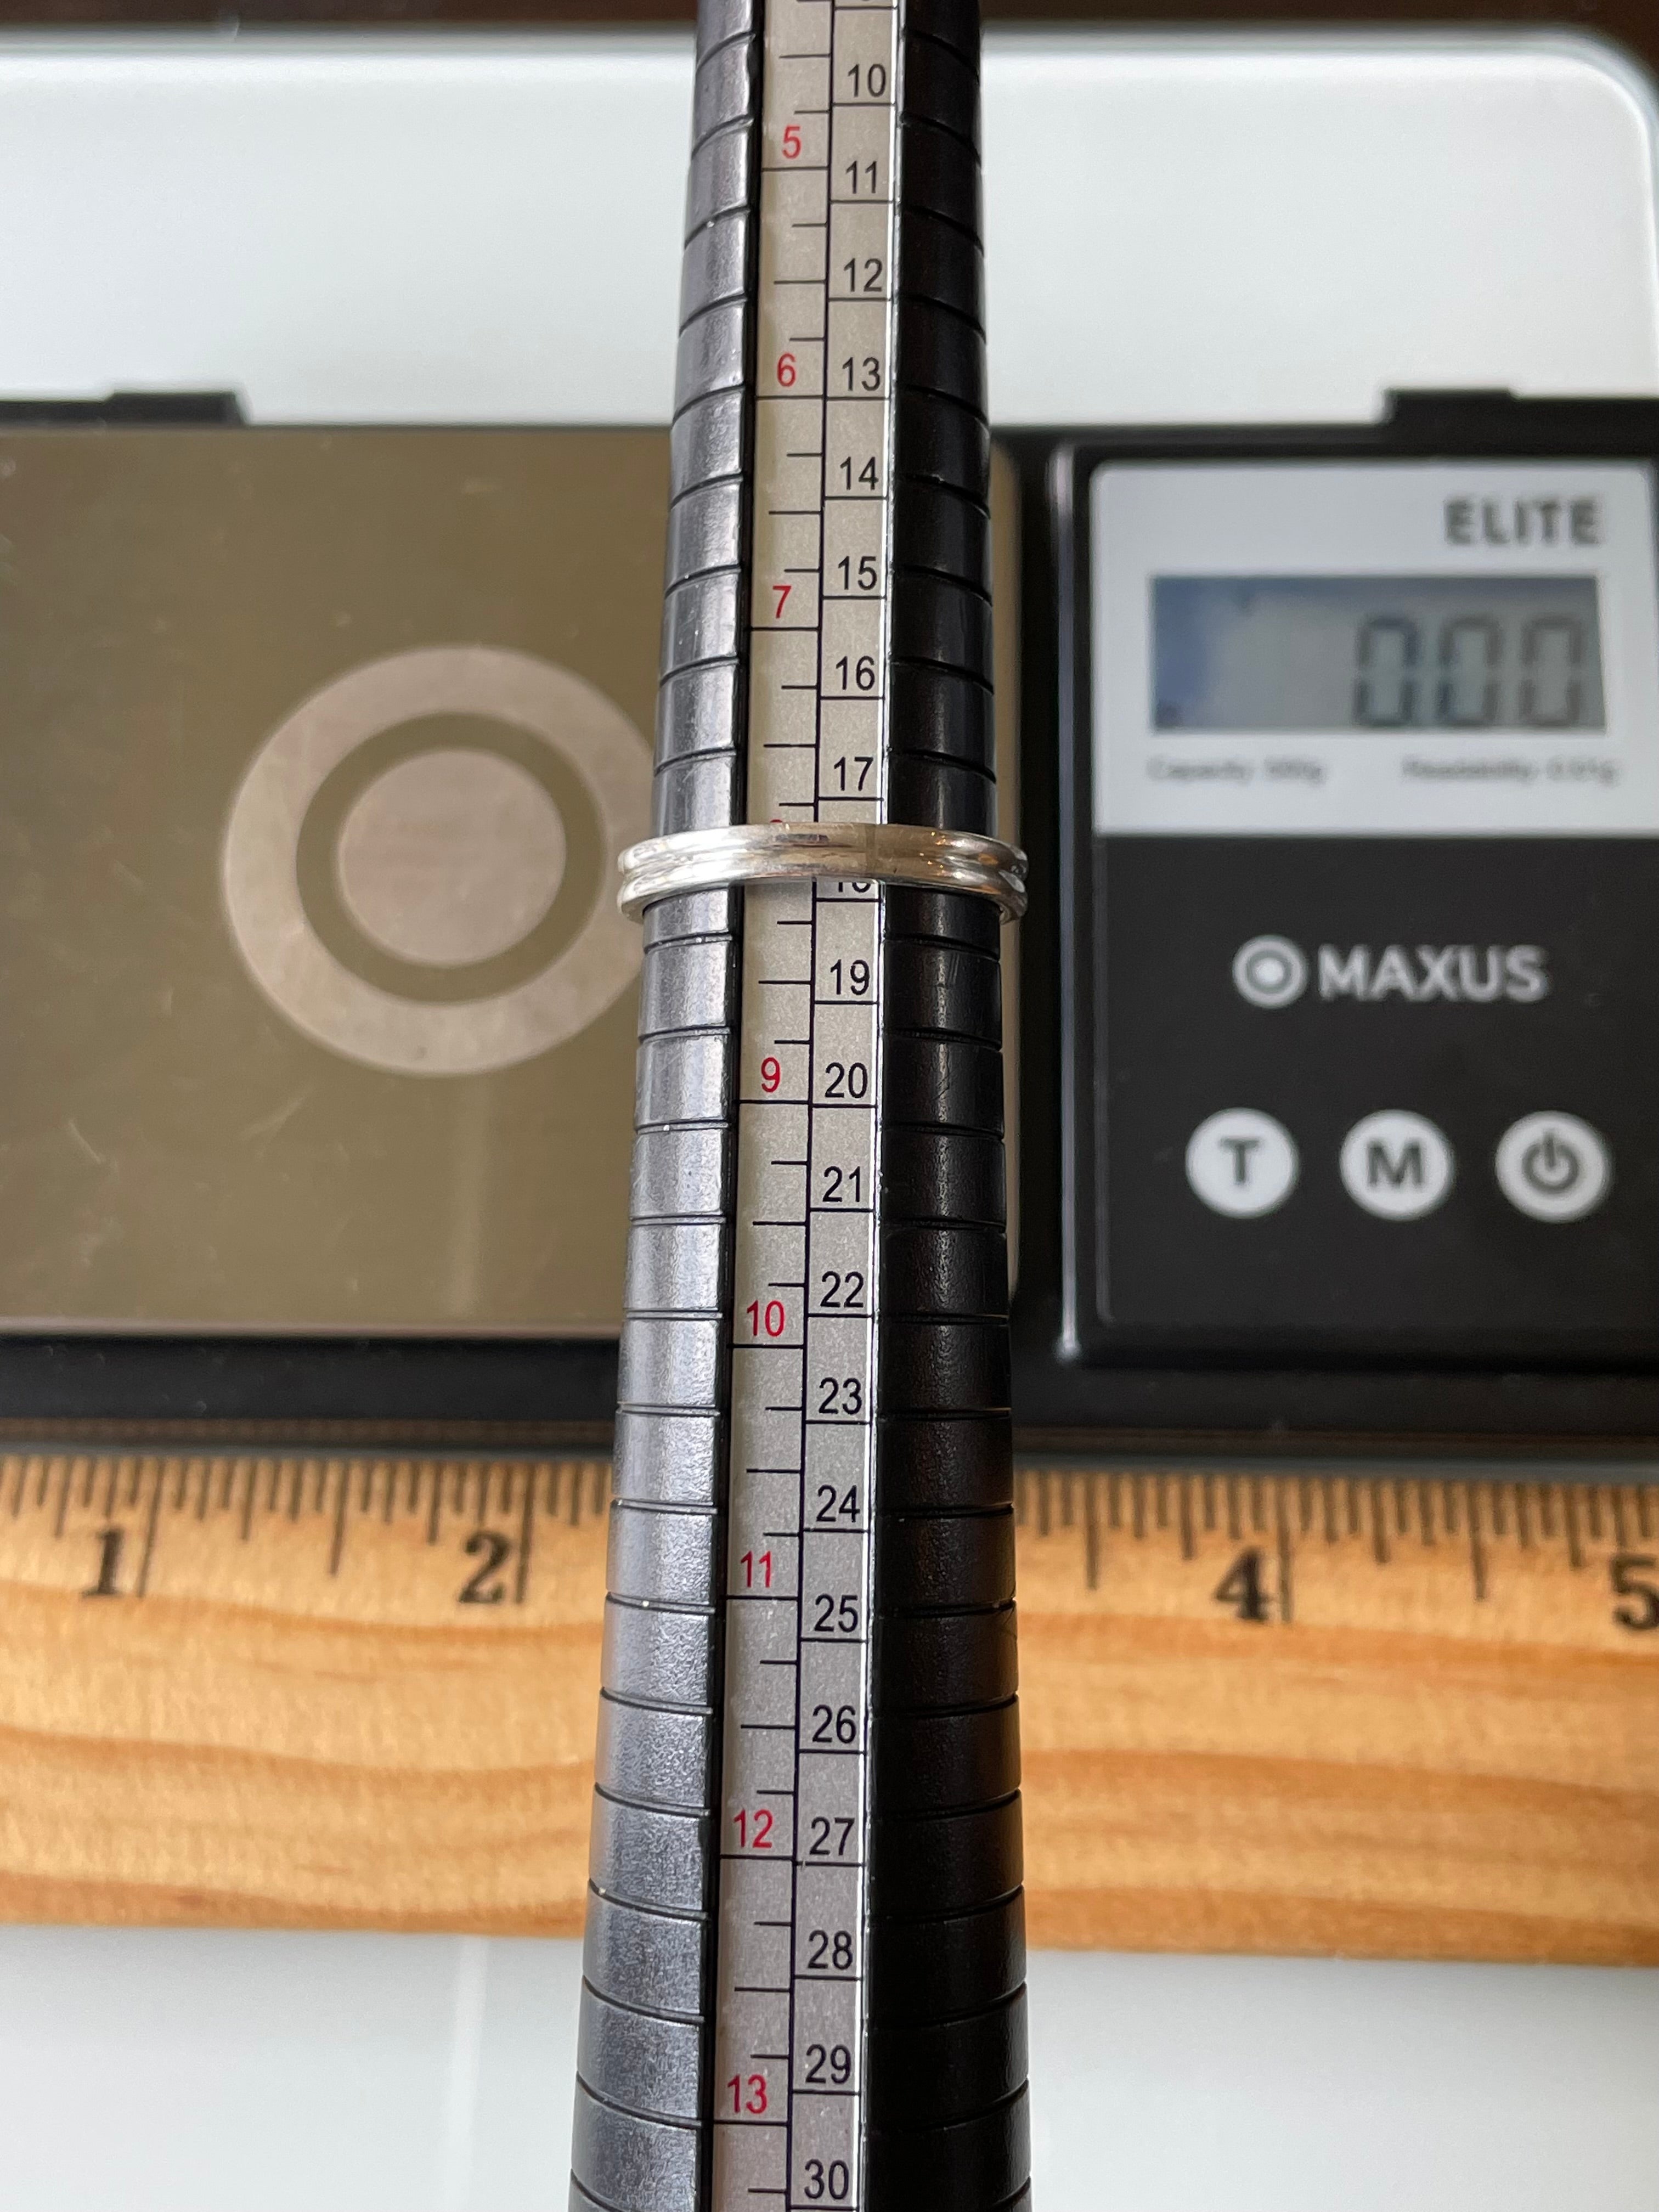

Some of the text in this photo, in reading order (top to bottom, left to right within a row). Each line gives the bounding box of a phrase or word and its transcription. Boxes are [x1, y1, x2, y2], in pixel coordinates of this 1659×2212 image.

[848, 63, 887, 98] 10
[782, 125, 802, 159] 5
[845, 160, 878, 195] 11
[843, 257, 883, 292] 12
[777, 353, 797, 387] 6
[842, 356, 881, 392] 13
[839, 455, 879, 491] 14
[1443, 495, 1605, 548] ELITE
[837, 555, 878, 591] 15
[772, 584, 792, 618] 7
[835, 655, 876, 691] 16
[833, 756, 874, 792] 17
[830, 958, 871, 996] 19
[1318, 944, 1548, 1003] MAXUS
[761, 1056, 782, 1093] 9
[824, 1062, 868, 1099] 20
[1219, 1137, 1261, 1186] T
[1365, 1139, 1426, 1190] M
[821, 1165, 861, 1203] 21
[819, 1270, 865, 1309] 22
[748, 1300, 785, 1337] 10
[817, 1376, 863, 1416] 23
[815, 1484, 861, 1523] 24
[82, 1528, 125, 1597] 1
[458, 1528, 511, 1604] 2
[741, 1551, 772, 1588] 11
[1214, 1546, 1272, 1624] 4
[1610, 1551, 1659, 1632] 5
[813, 1593, 859, 1634] 25
[811, 1703, 857, 1745] 26
[734, 1809, 774, 1849] 12
[808, 1816, 856, 1857] 27
[806, 1929, 854, 1971] 28
[804, 2043, 853, 2086] 29
[727, 2074, 768, 2115] 13
[803, 2158, 850, 2202] 30
